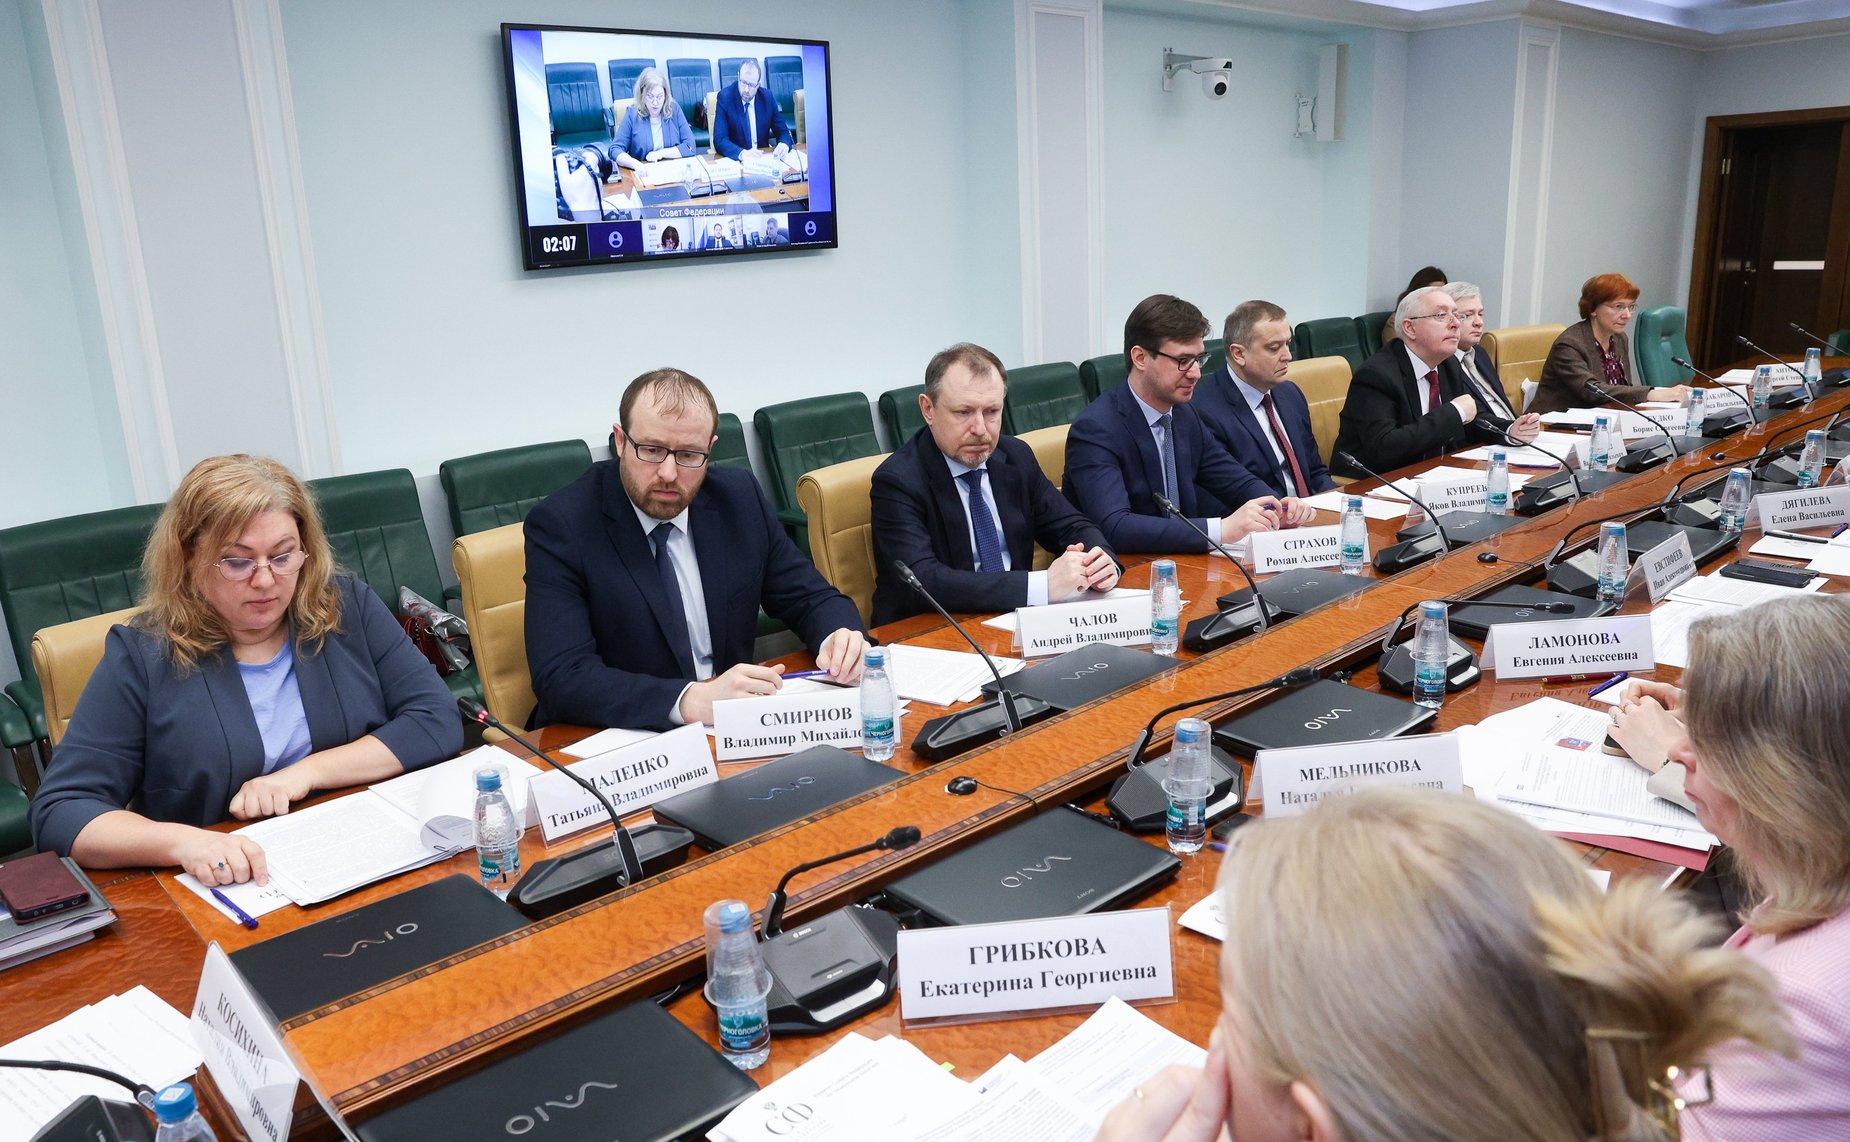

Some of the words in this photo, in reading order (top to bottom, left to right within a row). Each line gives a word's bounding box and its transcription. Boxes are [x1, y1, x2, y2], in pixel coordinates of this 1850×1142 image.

[660, 208, 682, 217] Совет
[684, 207, 725, 217] Федерации
[543, 235, 577, 253] 02:07
[1428, 502, 1450, 511] Яков
[1781, 496, 1831, 510] ДЯГИЛЕВА
[1771, 514, 1797, 524] Елена
[1799, 509, 1845, 521] Васильевна
[1284, 536, 1337, 551] СТРАХОВ
[1266, 555, 1298, 567] Роман
[1300, 551, 1340, 564] Алексее
[1069, 613, 1118, 628] ЧАЛОВ
[1031, 634, 1073, 649] Андрей
[1076, 626, 1152, 644] Владимирови
[1528, 632, 1620, 649] ЛАМОНОВА
[1513, 656, 1565, 668] Евгения
[1569, 651, 1638, 665] Алексеевна
[760, 707, 853, 727] СМИРНОВ
[723, 734, 796, 750] Владимир
[801, 728, 863, 743] Михайло
[1300, 758, 1421, 782] МЕЛЬНИКОВА
[548, 801, 608, 828] Татьяна
[612, 766, 708, 807] Владимировна
[969, 937, 1107, 965] ГРИБКОВА
[920, 976, 1033, 998] Екатерина
[1041, 965, 1157, 989] Георгиевна
[217, 992, 269, 1085] КОСИХИНА
